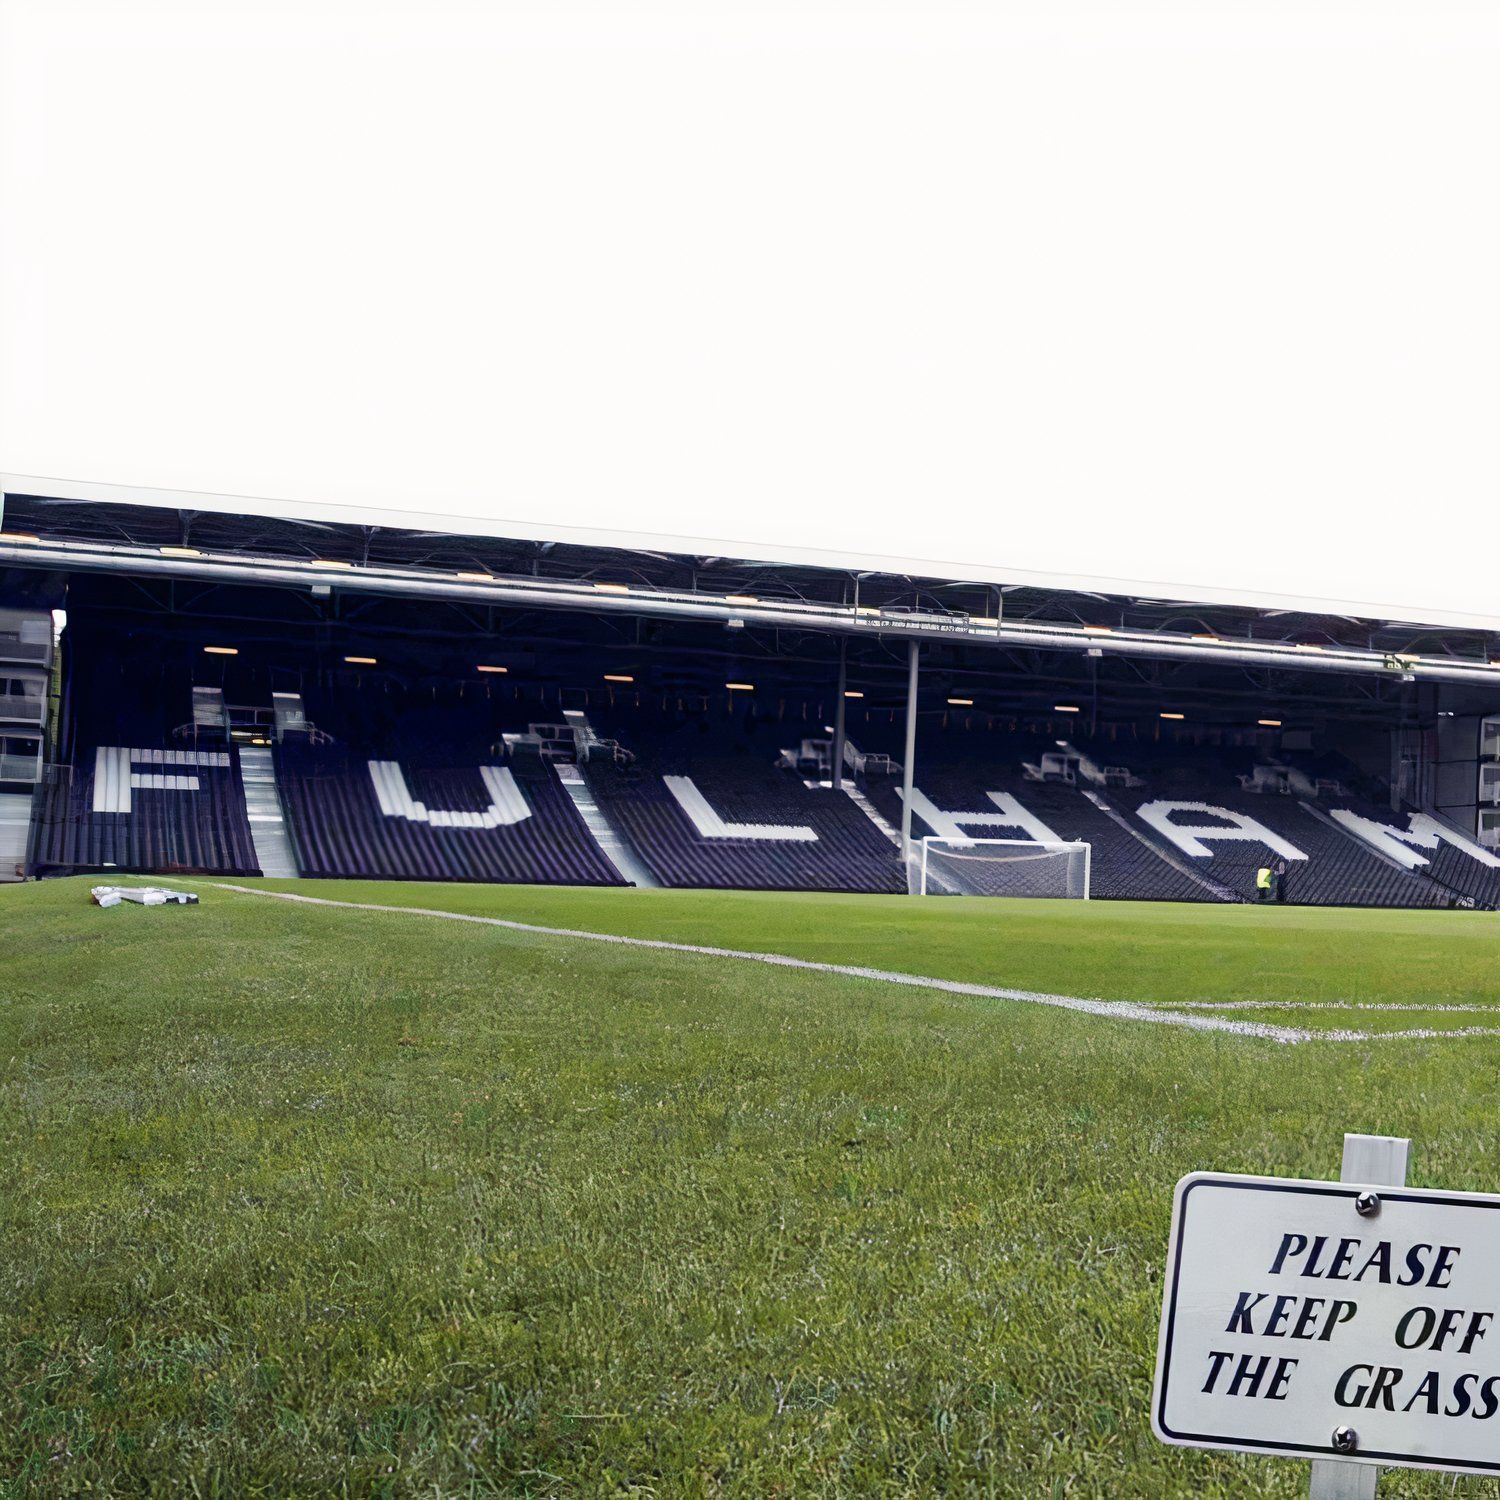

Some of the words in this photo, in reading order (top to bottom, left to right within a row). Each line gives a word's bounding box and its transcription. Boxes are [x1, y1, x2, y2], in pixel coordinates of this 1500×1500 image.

[1268, 1233, 1461, 1289] PLEASE
[1224, 1291, 1358, 1342] KEEP
[1394, 1306, 1494, 1355] OFF
[1200, 1350, 1300, 1401] THE
